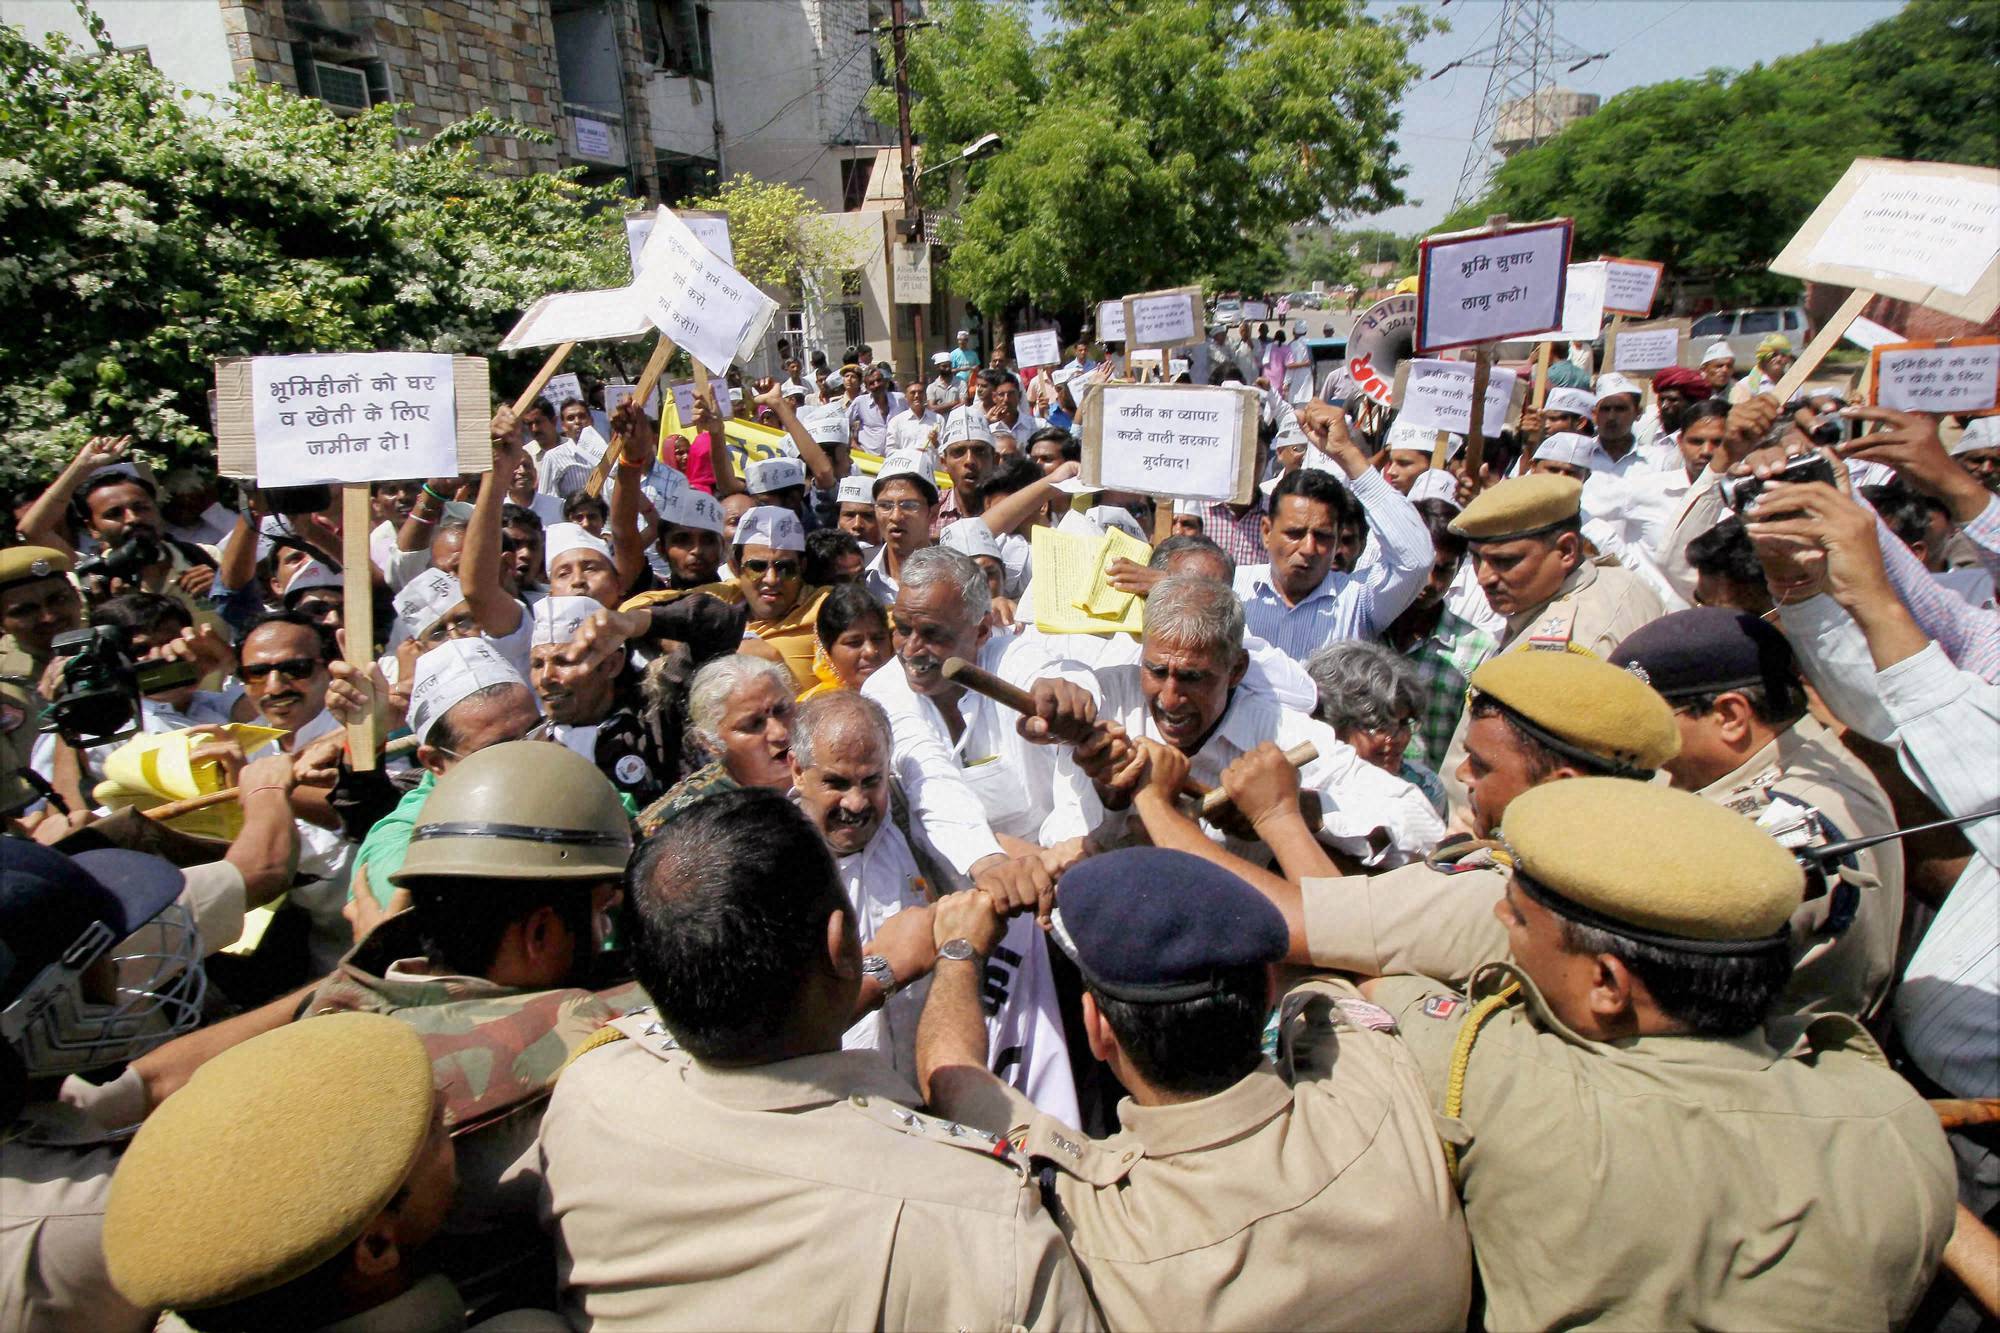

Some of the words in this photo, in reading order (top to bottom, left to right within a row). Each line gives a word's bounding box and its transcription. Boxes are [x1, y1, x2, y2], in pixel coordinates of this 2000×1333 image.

[1461, 255, 1491, 278] भूमि
[1496, 251, 1534, 272] सुधार
[1462, 294, 1492, 311] लागू
[1362, 300, 1414, 330] IFIER
[270, 373, 363, 405] भूमिहीनों
[370, 372, 398, 392] को
[405, 376, 436, 390] घर
[1454, 373, 1467, 382] का
[278, 412, 298, 426] व
[305, 403, 356, 427] खेती
[363, 403, 383, 422] के
[390, 401, 430, 421] लिए
[1120, 404, 1154, 418] जमीन
[1158, 409, 1174, 419] का
[1177, 410, 1219, 422] व्यापार
[306, 434, 371, 455] जमीन
[377, 431, 409, 451] दो!
[1116, 428, 1144, 441] करने
[1147, 430, 1175, 444] वाली
[1178, 435, 1220, 447] सरकार
